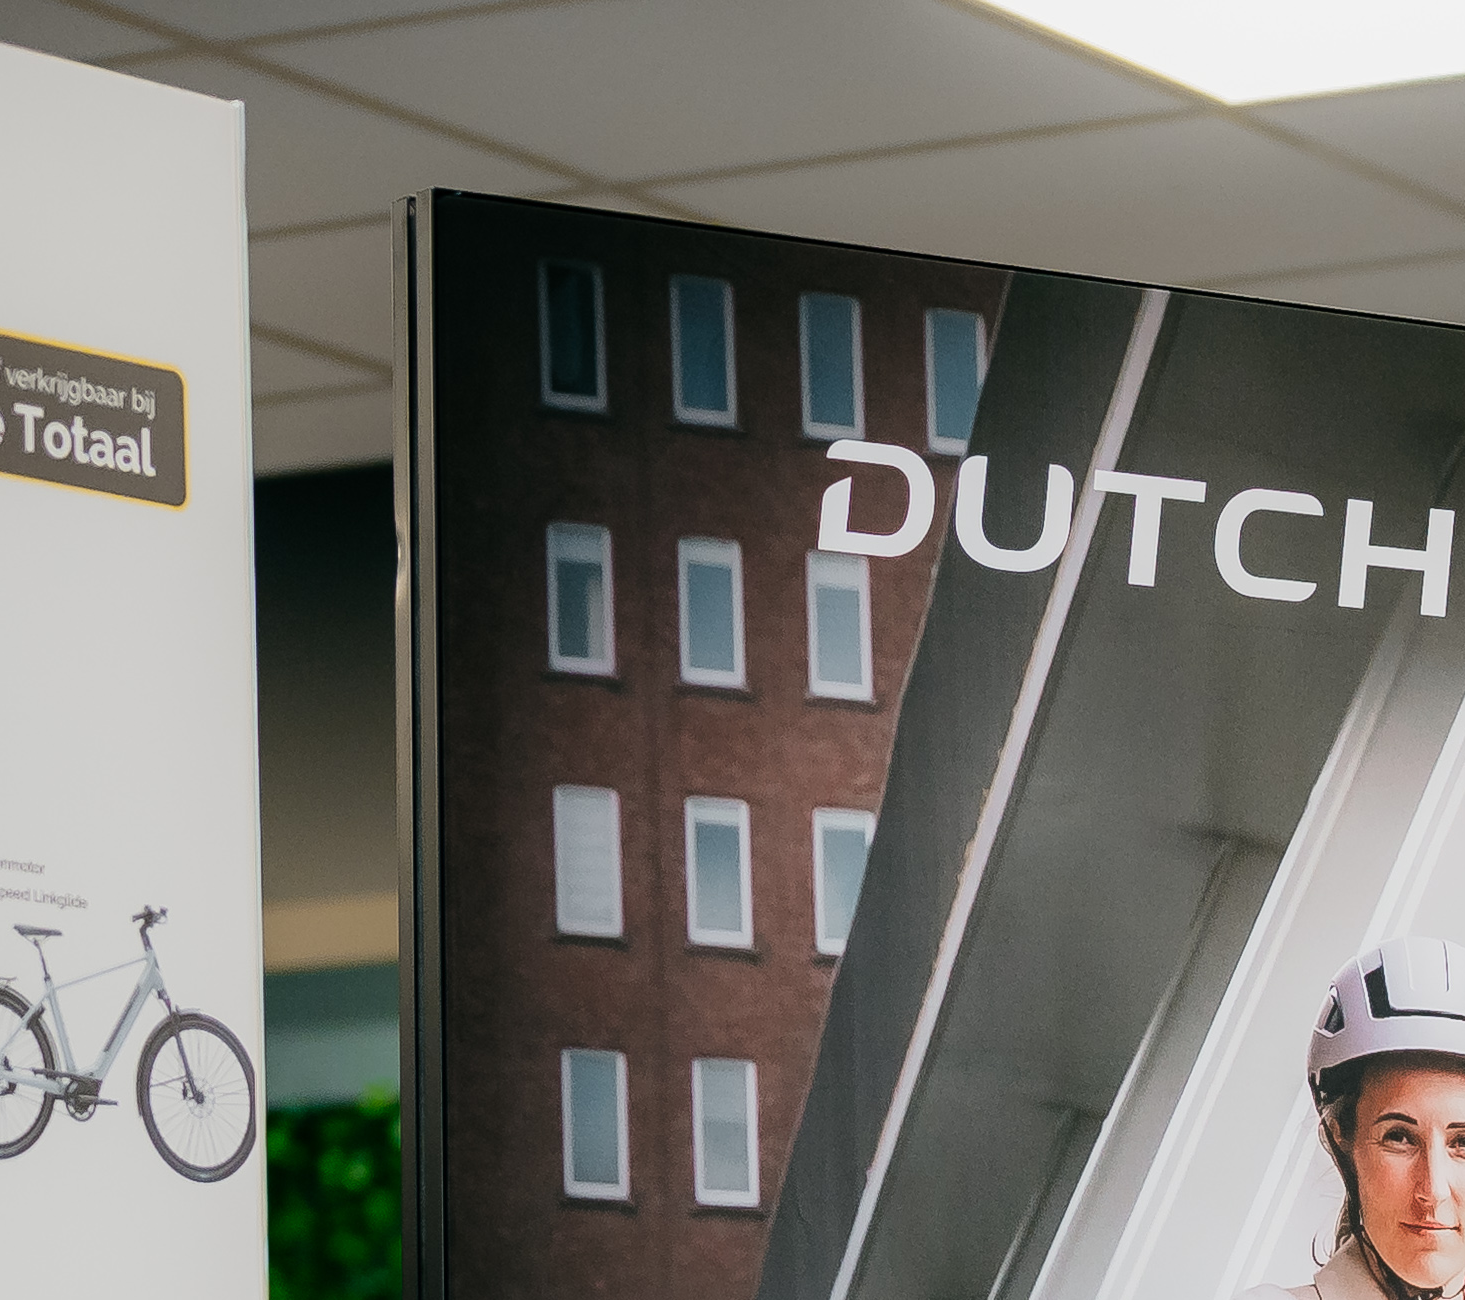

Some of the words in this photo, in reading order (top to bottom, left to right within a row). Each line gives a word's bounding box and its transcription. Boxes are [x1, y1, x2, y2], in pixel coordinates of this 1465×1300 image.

[4, 365, 125, 408] verkrijgbaar
[132, 387, 156, 420] bij
[14, 403, 157, 477] Totaal
[818, 438, 1456, 618] DUTCH
